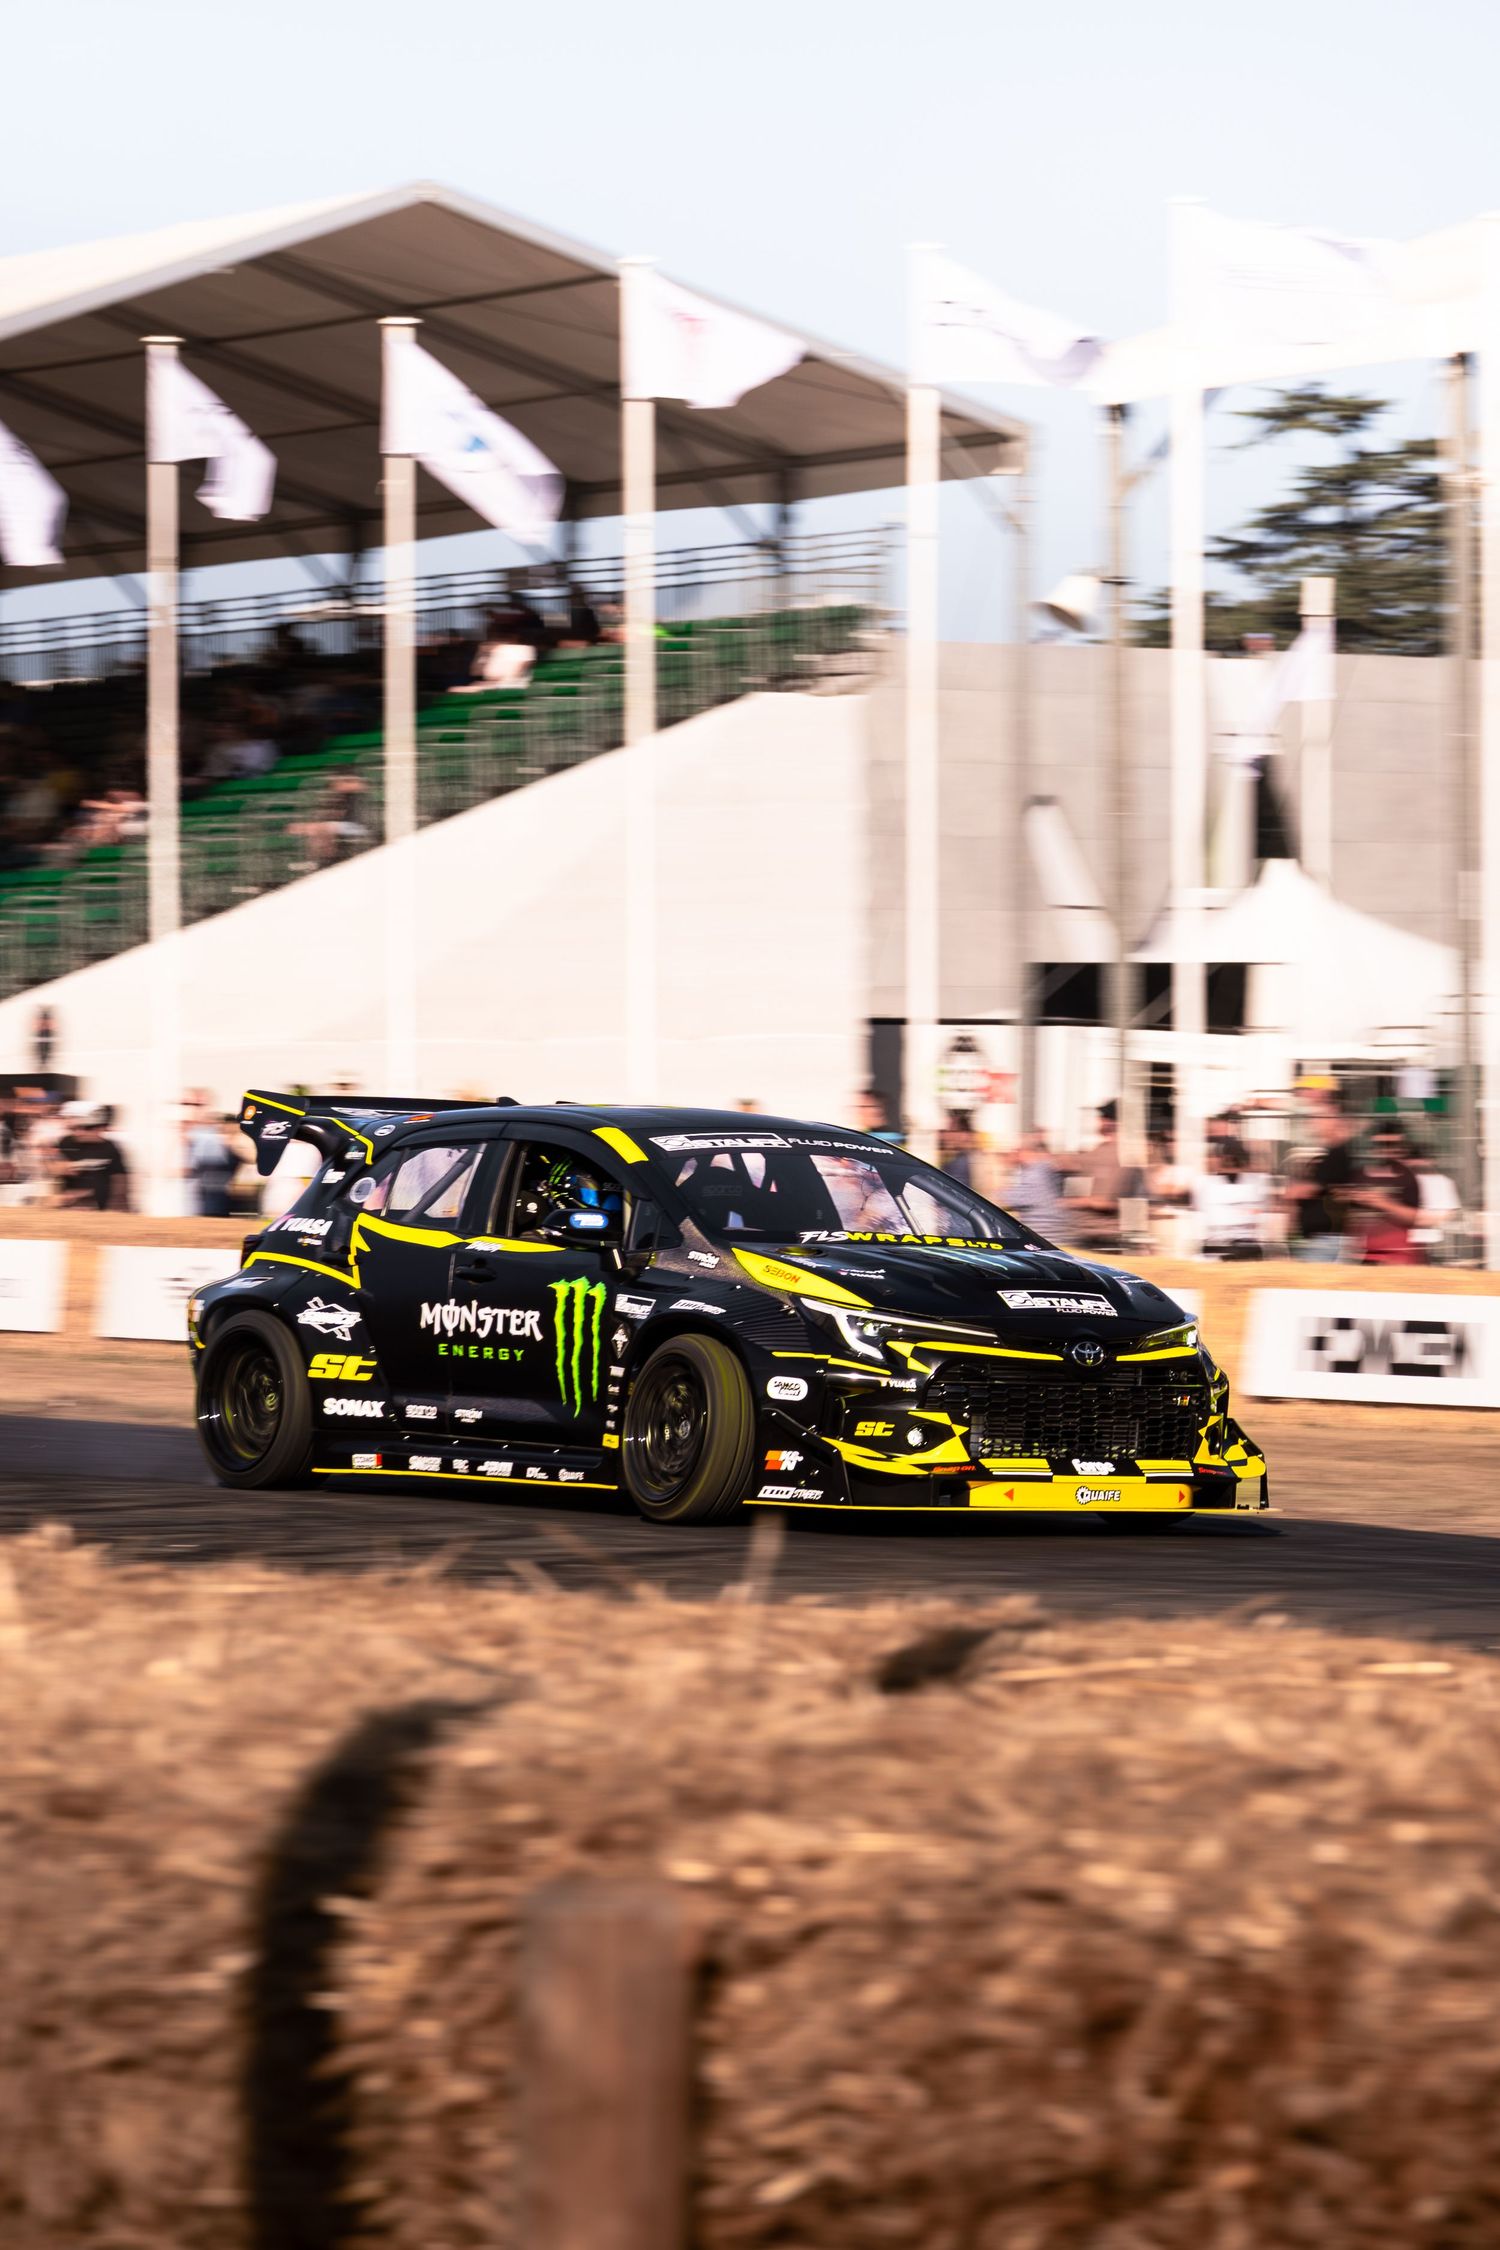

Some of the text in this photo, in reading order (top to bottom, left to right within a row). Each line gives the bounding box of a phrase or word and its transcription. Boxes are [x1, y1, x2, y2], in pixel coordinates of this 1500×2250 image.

[788, 1138, 832, 1146] FLUID
[833, 1141, 894, 1154] POWER
[763, 1264, 801, 1284] SEBON
[1034, 1296, 1117, 1313] STAUFF
[437, 1343, 525, 1362] ENERGY
[322, 1398, 386, 1418] SONAX
[1075, 1485, 1122, 1505] QUAIFE
